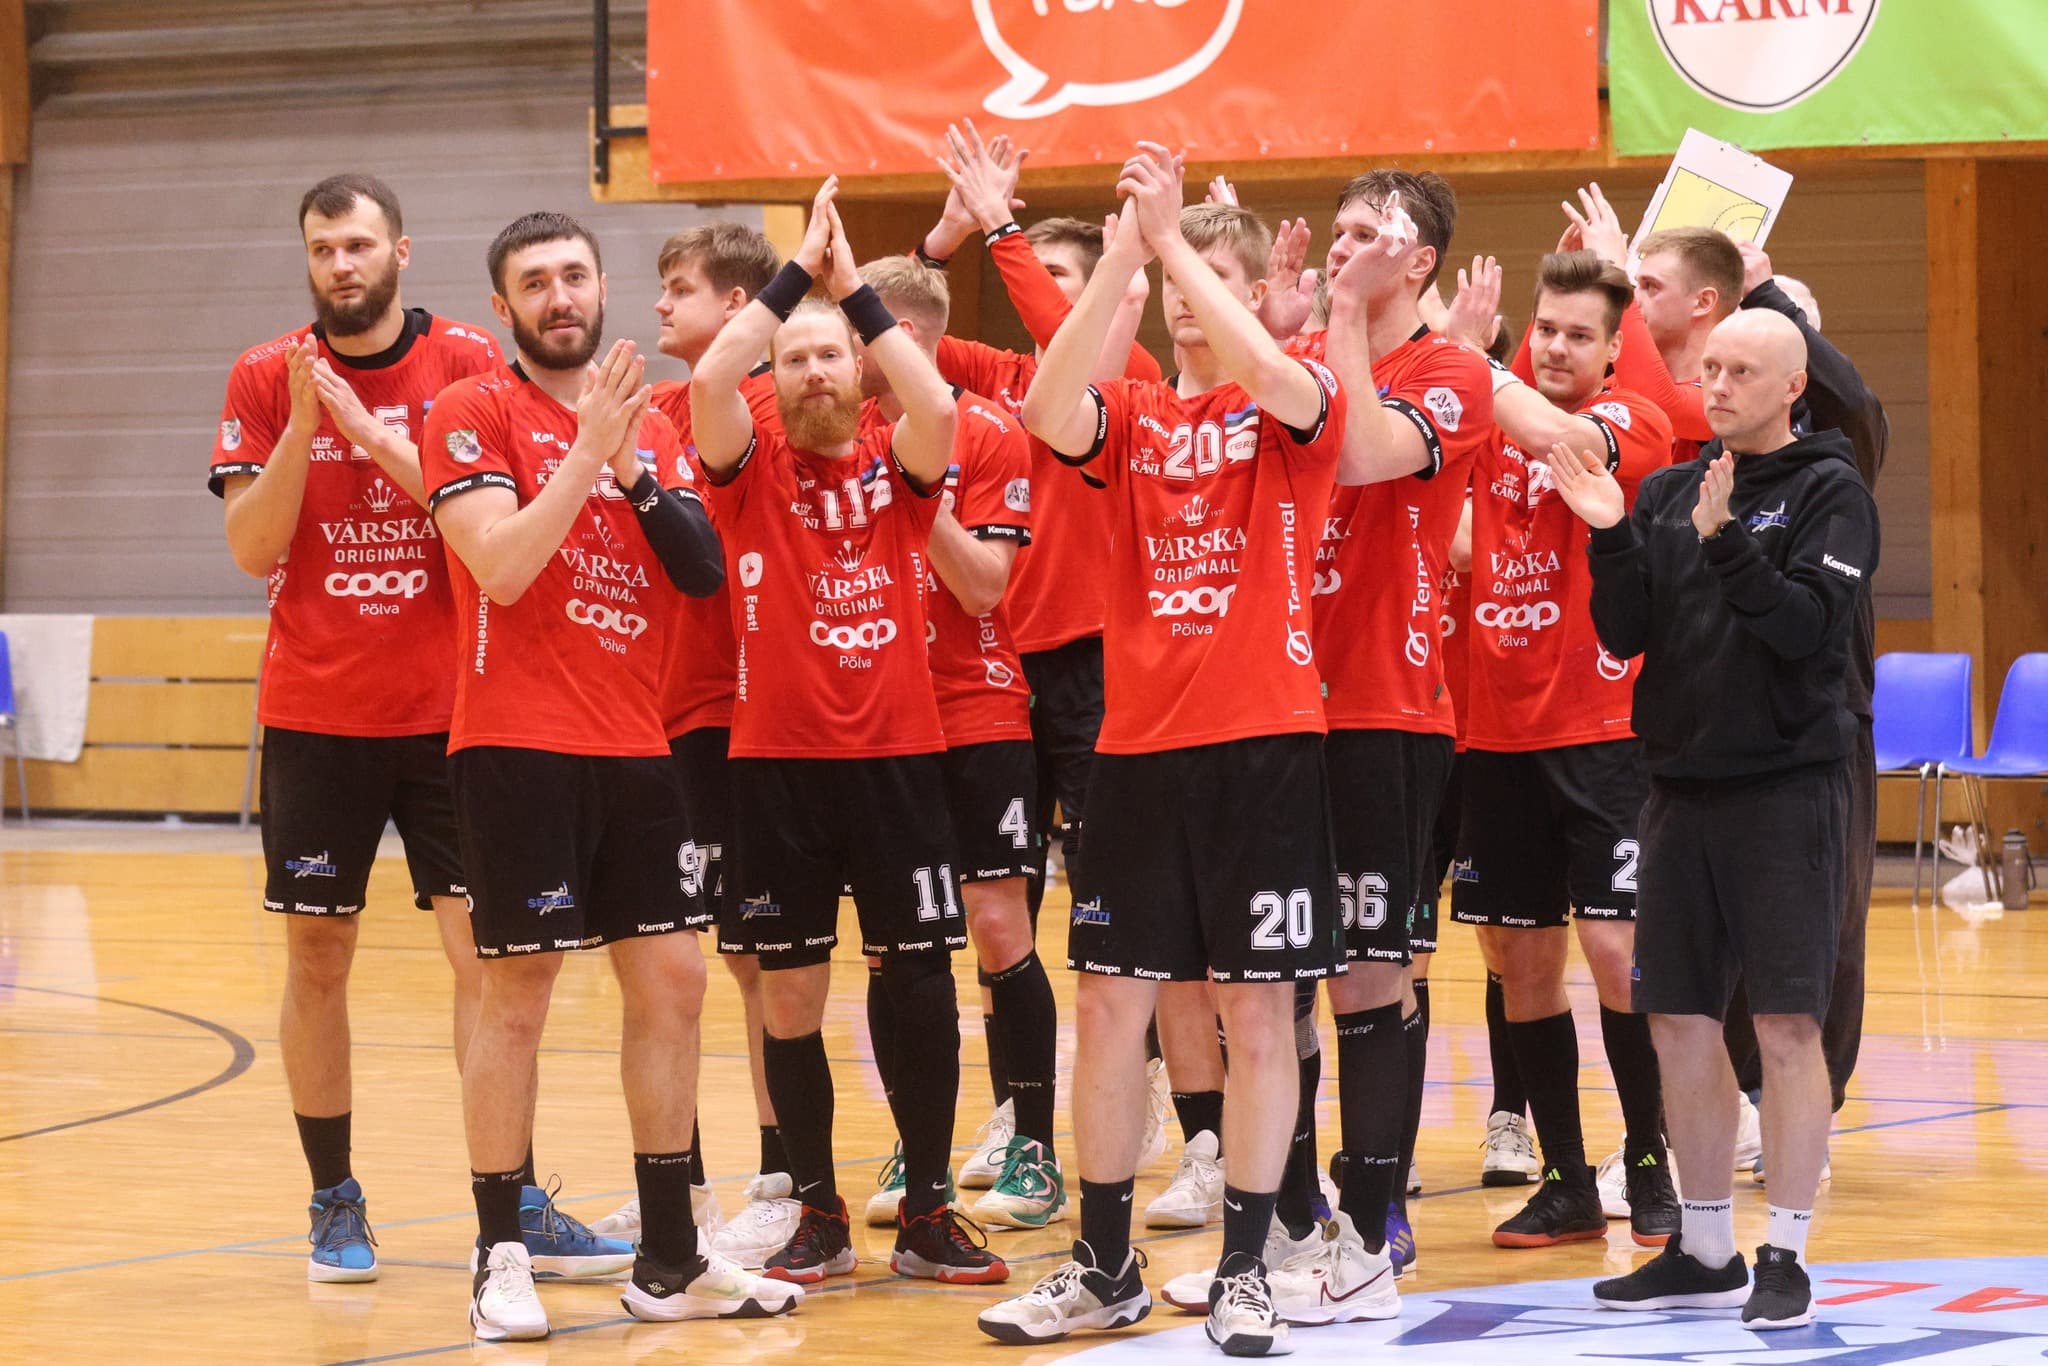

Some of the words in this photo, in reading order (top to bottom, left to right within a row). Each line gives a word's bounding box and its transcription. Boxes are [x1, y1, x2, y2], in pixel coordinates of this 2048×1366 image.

[1098, 406, 1108, 440] Kempa
[1408, 408, 1433, 440] Kempa
[1600, 422, 1616, 453] Kempa
[1163, 421, 1224, 482] 20
[439, 478, 472, 498] Kempa
[820, 478, 870, 532] 11
[318, 517, 438, 545] VÄRSKA
[988, 525, 1017, 537] Kempa
[1145, 527, 1248, 563] VÄRSKA
[334, 546, 427, 564] ORIGINAAL
[1278, 501, 1301, 616] Terminal
[1822, 553, 1861, 578] Kempa
[324, 570, 428, 599] coop
[806, 564, 894, 601] VÄRSKA
[1154, 558, 1241, 584] ORIGINAAL
[359, 603, 400, 616] Põlva
[744, 594, 759, 633] Eesti
[1475, 600, 1560, 631] coop
[809, 617, 898, 650] coop
[1172, 622, 1214, 637] Põlva
[839, 655, 873, 670] Põlva
[998, 797, 1028, 849] 4
[977, 866, 1010, 879] Kempa
[912, 863, 960, 923] 11
[1337, 872, 1389, 931] 66
[295, 902, 328, 916] Kempa
[1250, 887, 1314, 951] 20
[1457, 911, 1489, 923] Kempa
[1502, 915, 1536, 928] Kempa
[1584, 905, 1618, 917] Kempa
[507, 942, 541, 954] Kempa
[554, 938, 579, 949] Kemp
[638, 920, 675, 933] Kempa
[721, 941, 744, 953] Kempa
[755, 940, 792, 953] Kempa
[805, 933, 835, 947] Kempa
[898, 940, 933, 952] Kempa
[945, 936, 967, 946] Kemp
[1367, 947, 1402, 960] Kempa
[1085, 961, 1121, 975] Kempa
[1134, 967, 1172, 981] Kempa
[1244, 969, 1281, 981] Kempa
[1295, 966, 1328, 979] Kempa
[1684, 1202, 1731, 1213] Kempa
